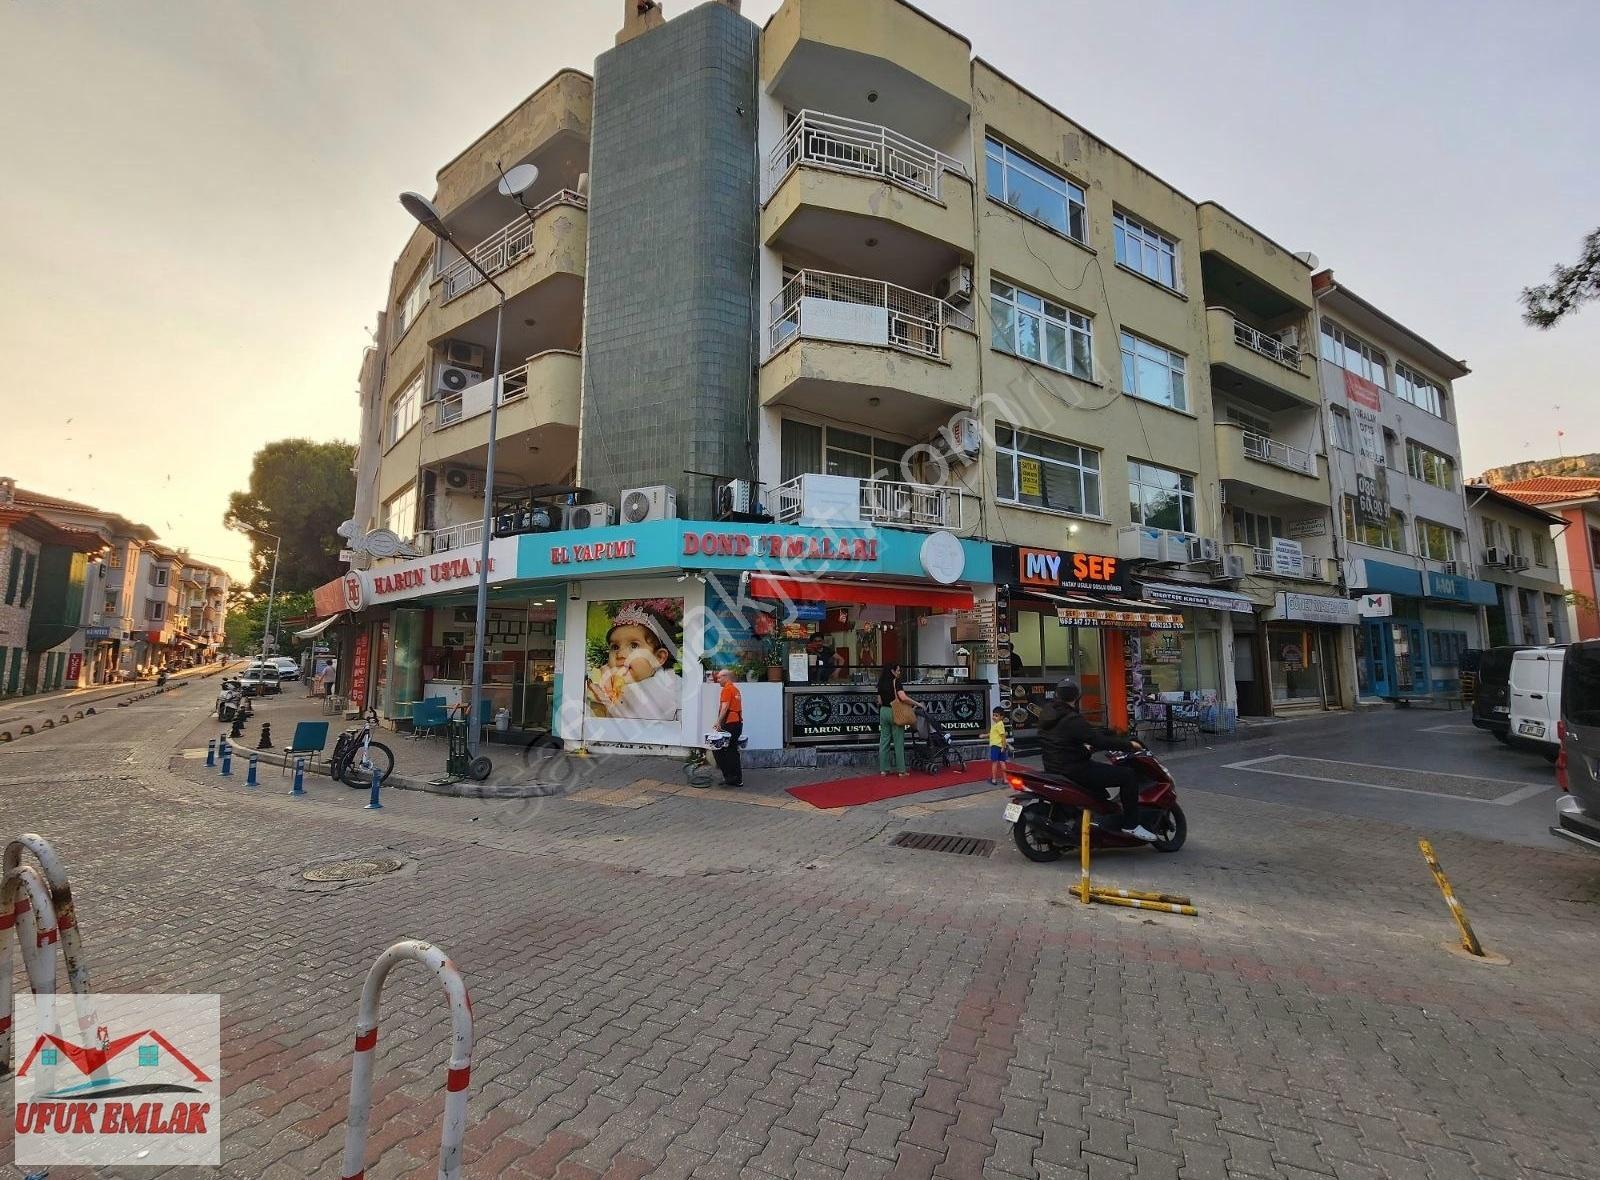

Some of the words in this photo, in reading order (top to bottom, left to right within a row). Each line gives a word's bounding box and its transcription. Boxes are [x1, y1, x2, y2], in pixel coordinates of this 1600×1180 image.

[551, 547, 570, 564] EL
[573, 540, 636, 562] YAPIMI
[683, 533, 877, 560] DONDURMALARI
[1026, 552, 1060, 580] MY
[1073, 553, 1116, 581] ŞEF
[375, 568, 425, 594] HARUN
[804, 726, 841, 734] HARUN
